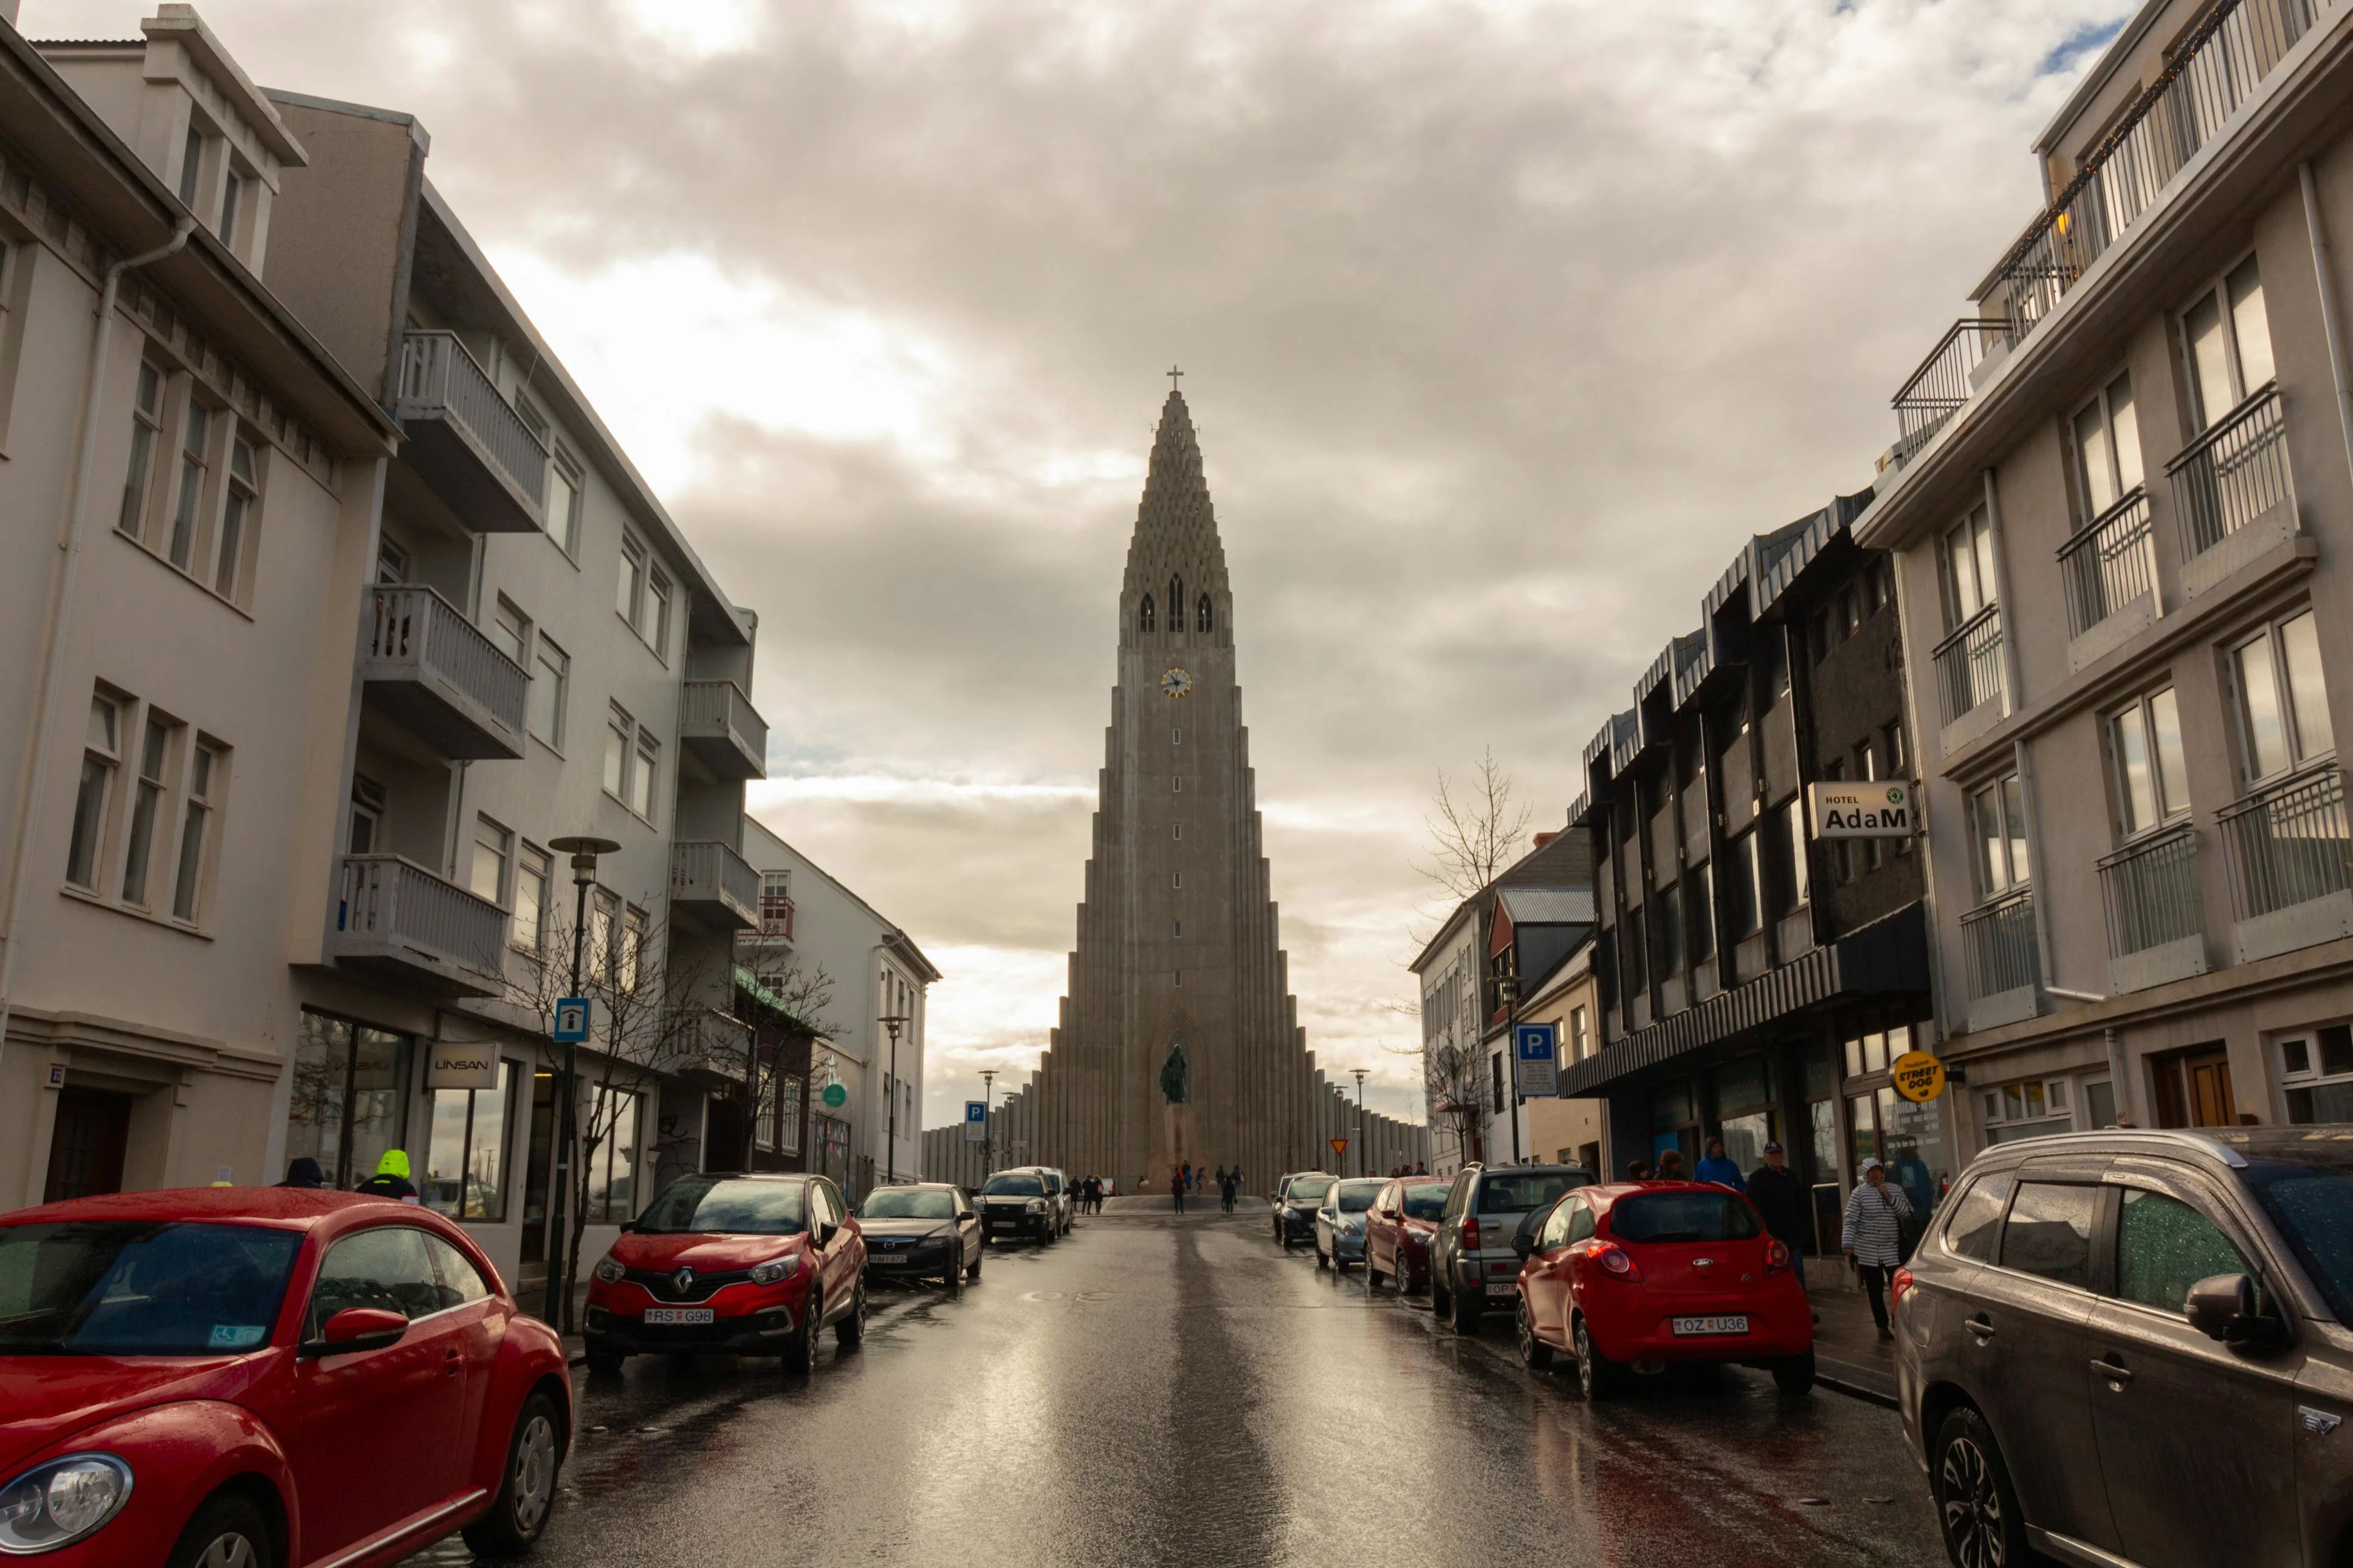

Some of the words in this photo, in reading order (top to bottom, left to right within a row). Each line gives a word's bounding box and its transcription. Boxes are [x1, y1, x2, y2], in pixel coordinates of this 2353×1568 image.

[1826, 809, 1906, 829] AdaM
[1527, 1033, 1544, 1055] P
[435, 1060, 488, 1070] LINSAN
[1900, 1065, 1938, 1081] STREET
[1909, 1077, 1932, 1089] DOG
[654, 1311, 673, 1321] RS
[685, 1311, 711, 1321] G98
[1684, 1320, 1705, 1332] OZ
[1717, 1318, 1745, 1330] U36
